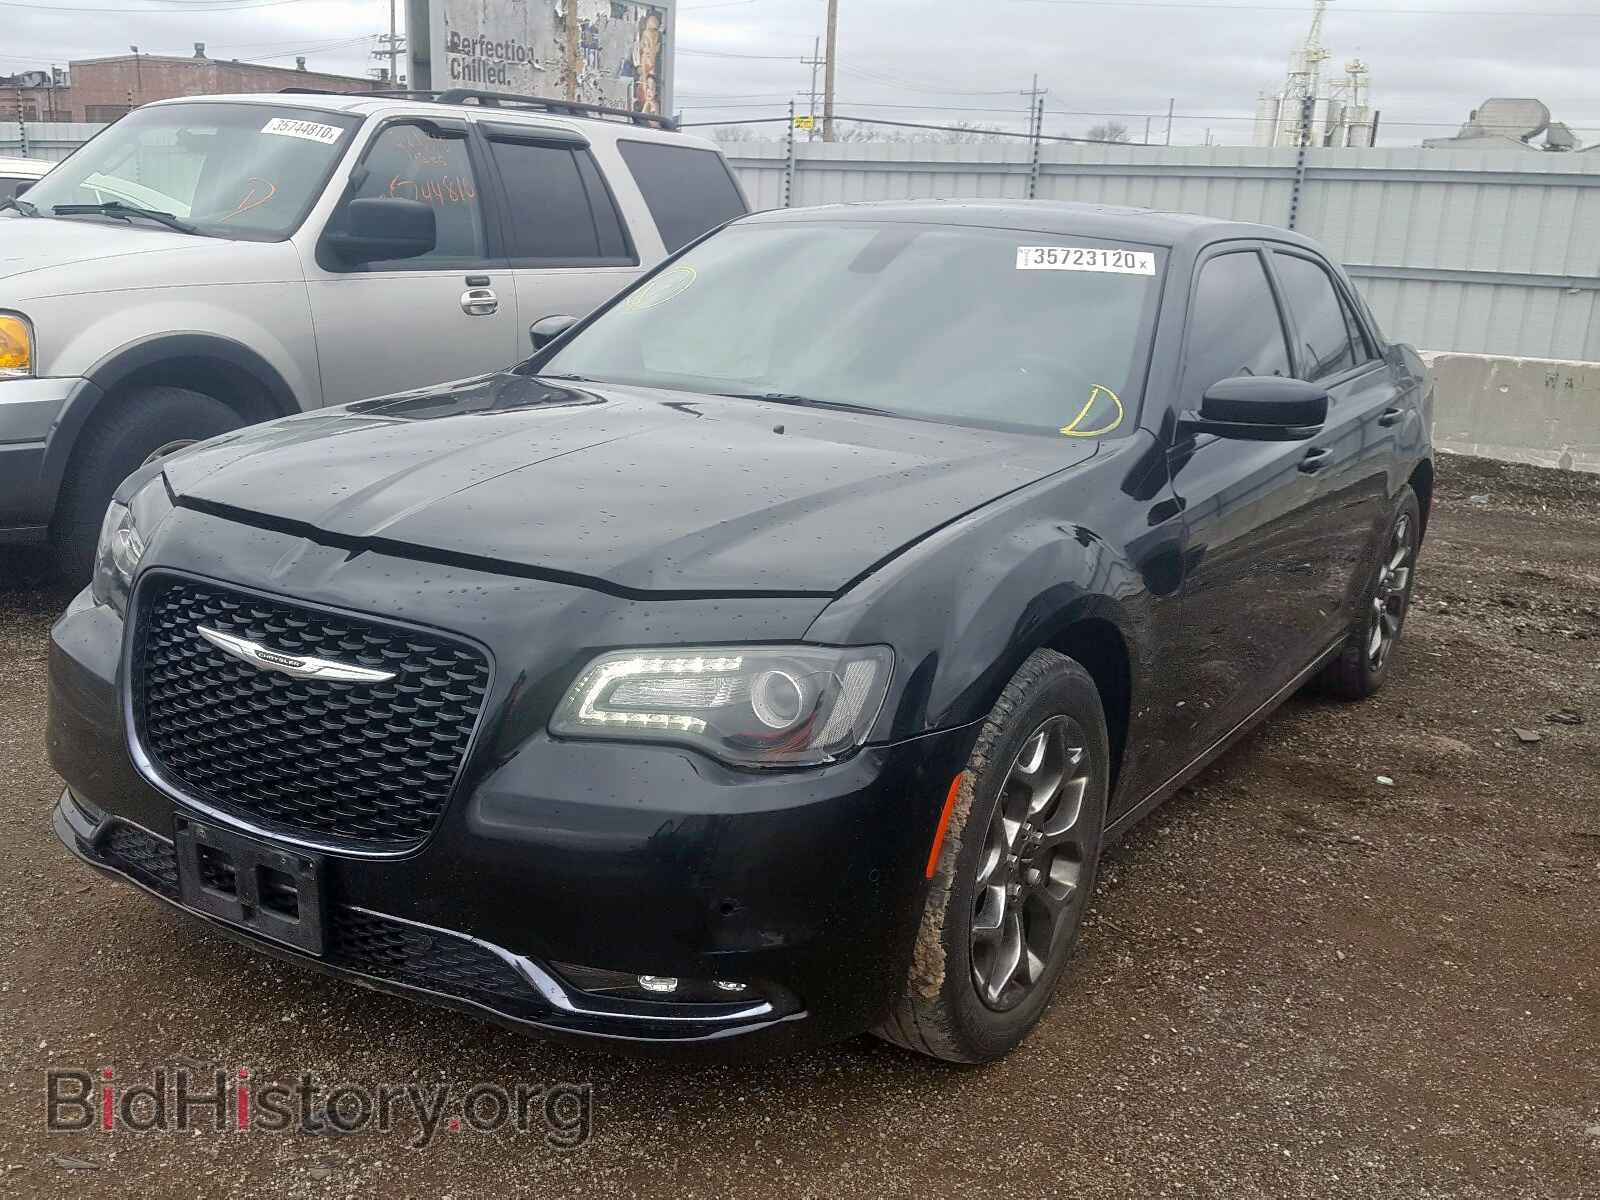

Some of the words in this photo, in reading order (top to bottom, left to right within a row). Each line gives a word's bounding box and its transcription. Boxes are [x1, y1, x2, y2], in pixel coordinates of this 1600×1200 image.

[449, 31, 538, 63] Perfection.
[450, 57, 511, 85] Chilled.
[1059, 384, 1123, 437] D
[258, 652, 301, 667] CHRYSLER
